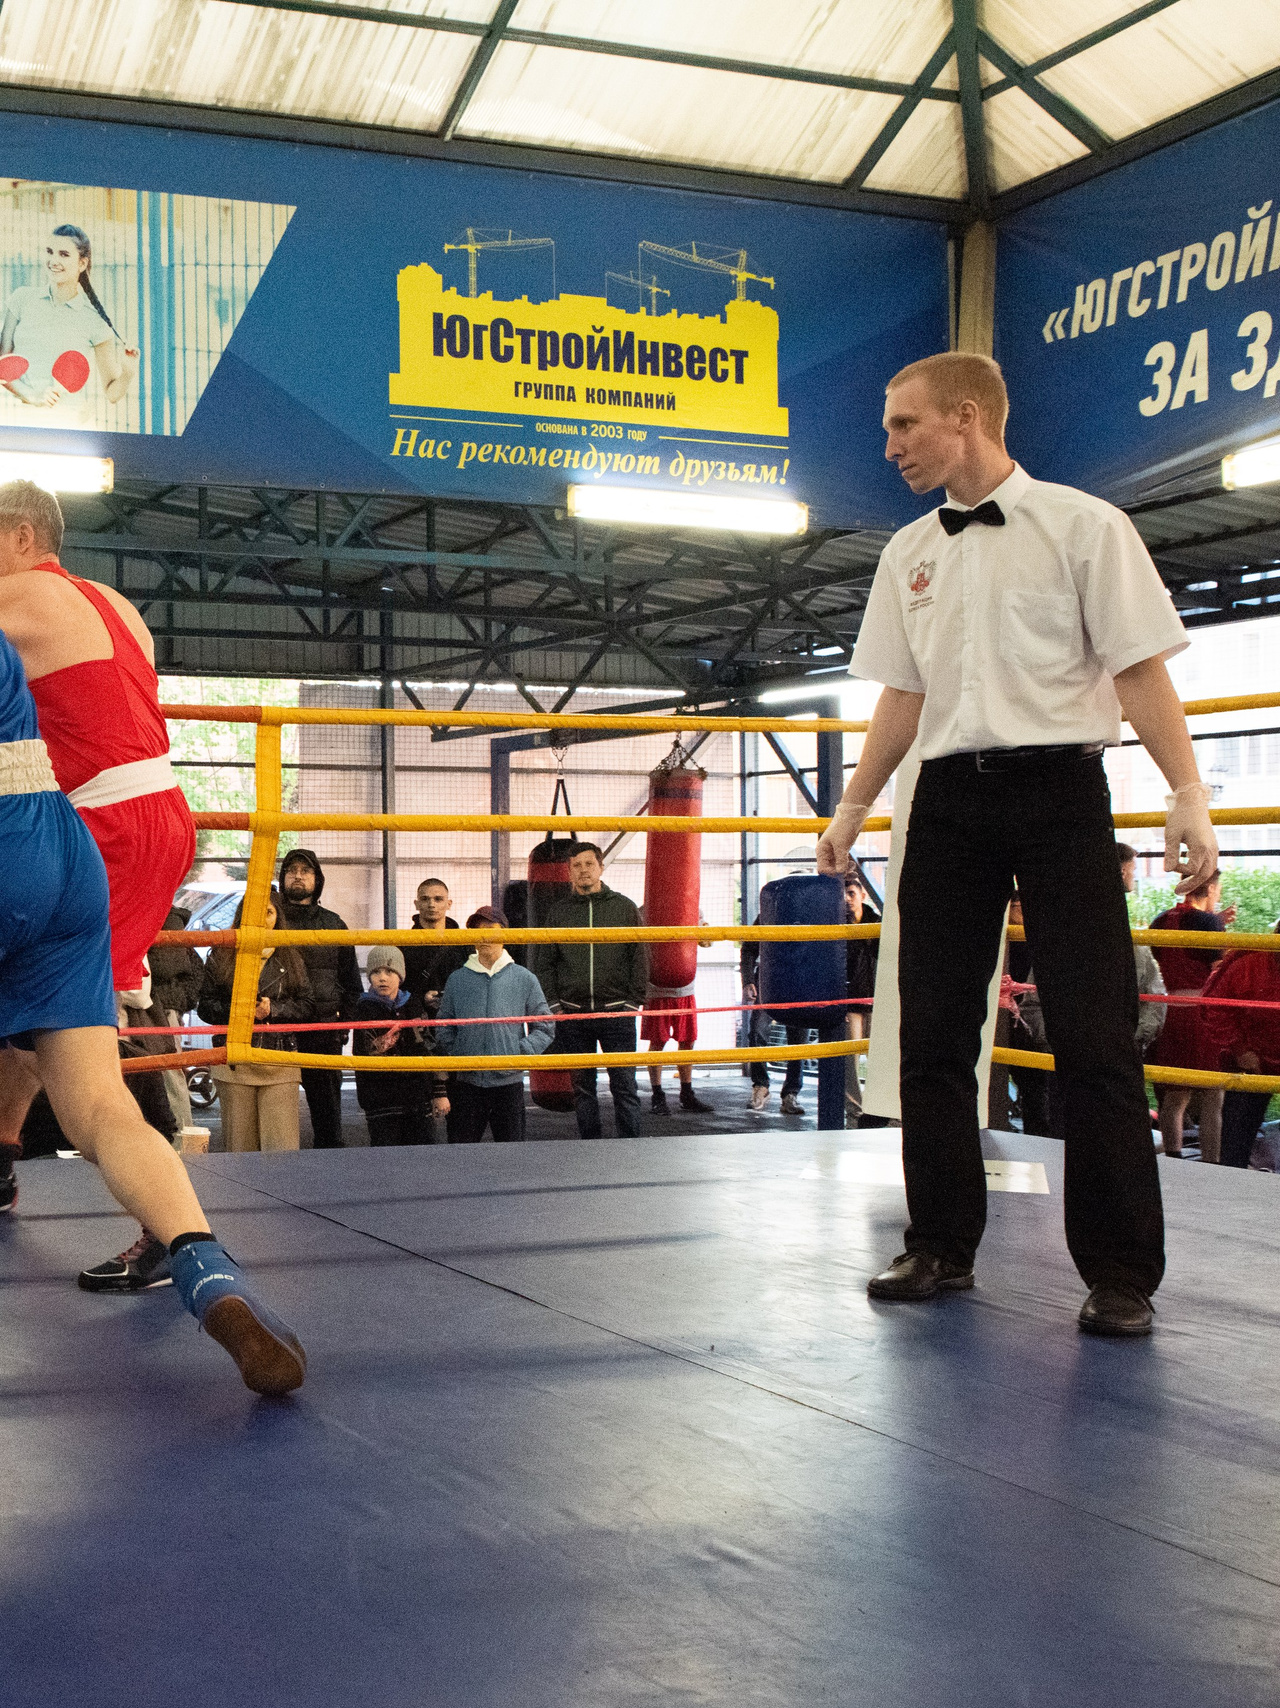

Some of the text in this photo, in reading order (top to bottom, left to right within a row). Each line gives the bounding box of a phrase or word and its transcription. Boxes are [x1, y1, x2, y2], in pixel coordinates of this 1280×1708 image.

[1042, 200, 1280, 344] «ЮГСТРОЙ
[432, 312, 750, 385] ЮгСтройИнвест
[1139, 331, 1210, 417] ЗА
[514, 381, 676, 411] ГРУППА КОМПАНИЙ
[389, 428, 790, 486] Нас рекомендуют друзьям!
[535, 422, 579, 436] ОСНОВАНА
[590, 423, 624, 439] 2003
[627, 429, 648, 442] ГОДУ
